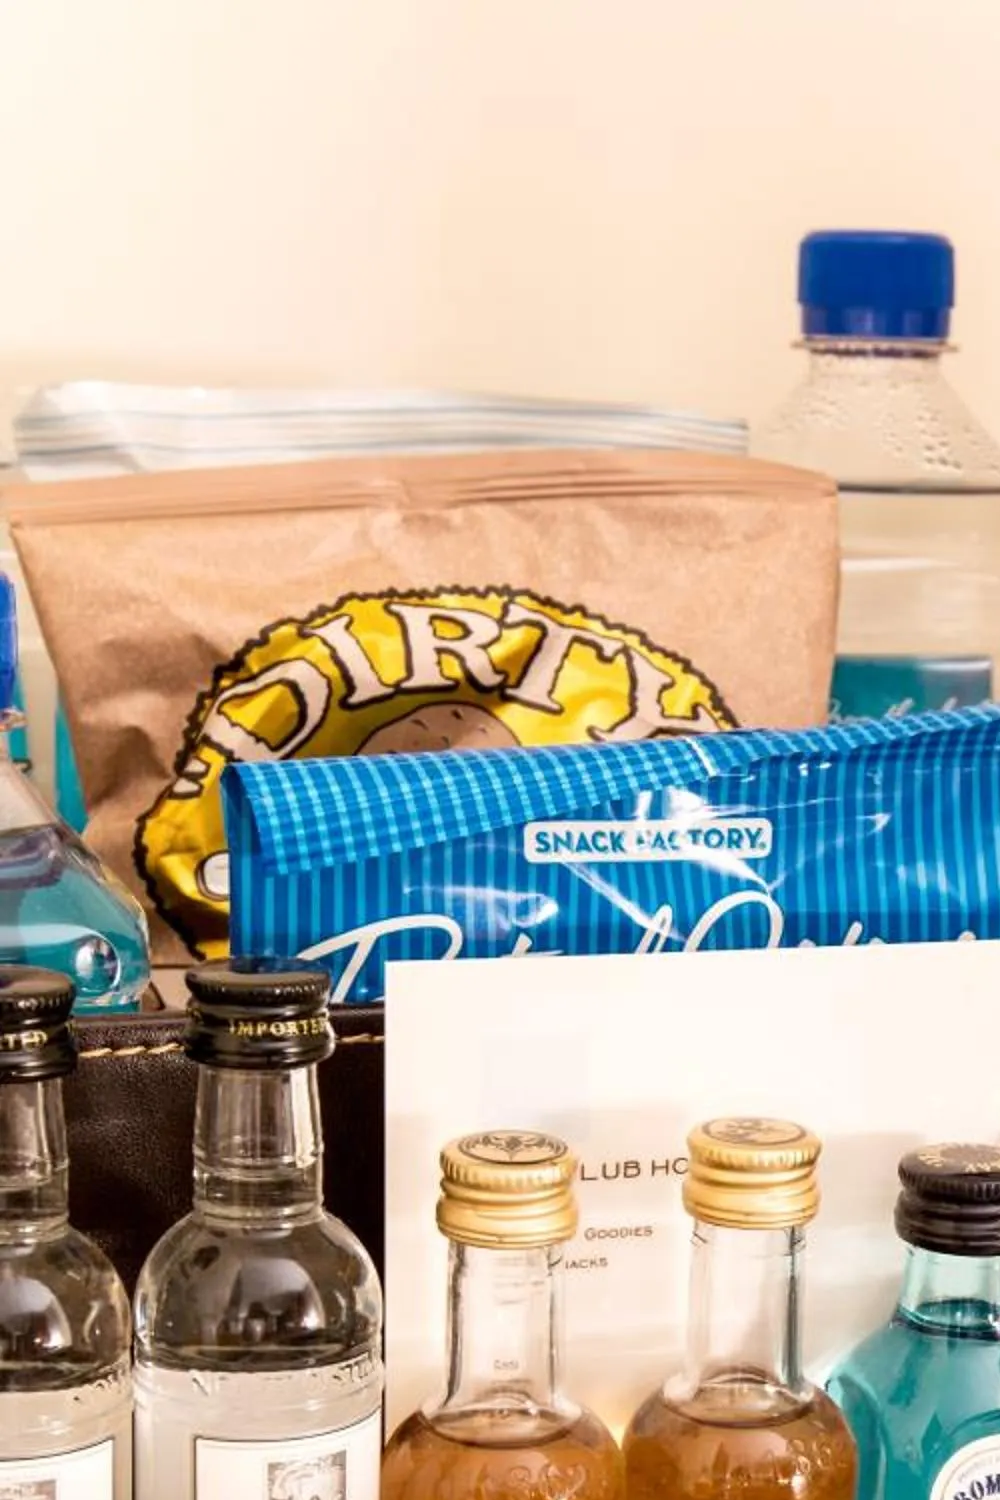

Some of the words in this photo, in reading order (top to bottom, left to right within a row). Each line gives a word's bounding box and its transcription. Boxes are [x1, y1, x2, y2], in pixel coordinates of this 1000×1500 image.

[197, 600, 717, 765] DIRTY
[534, 830, 627, 855] SNACK
[579, 1159, 642, 1182] LUB
[650, 1156, 689, 1177] HO
[583, 1225, 654, 1242] GOODIES
[564, 1256, 609, 1270] ACKS
